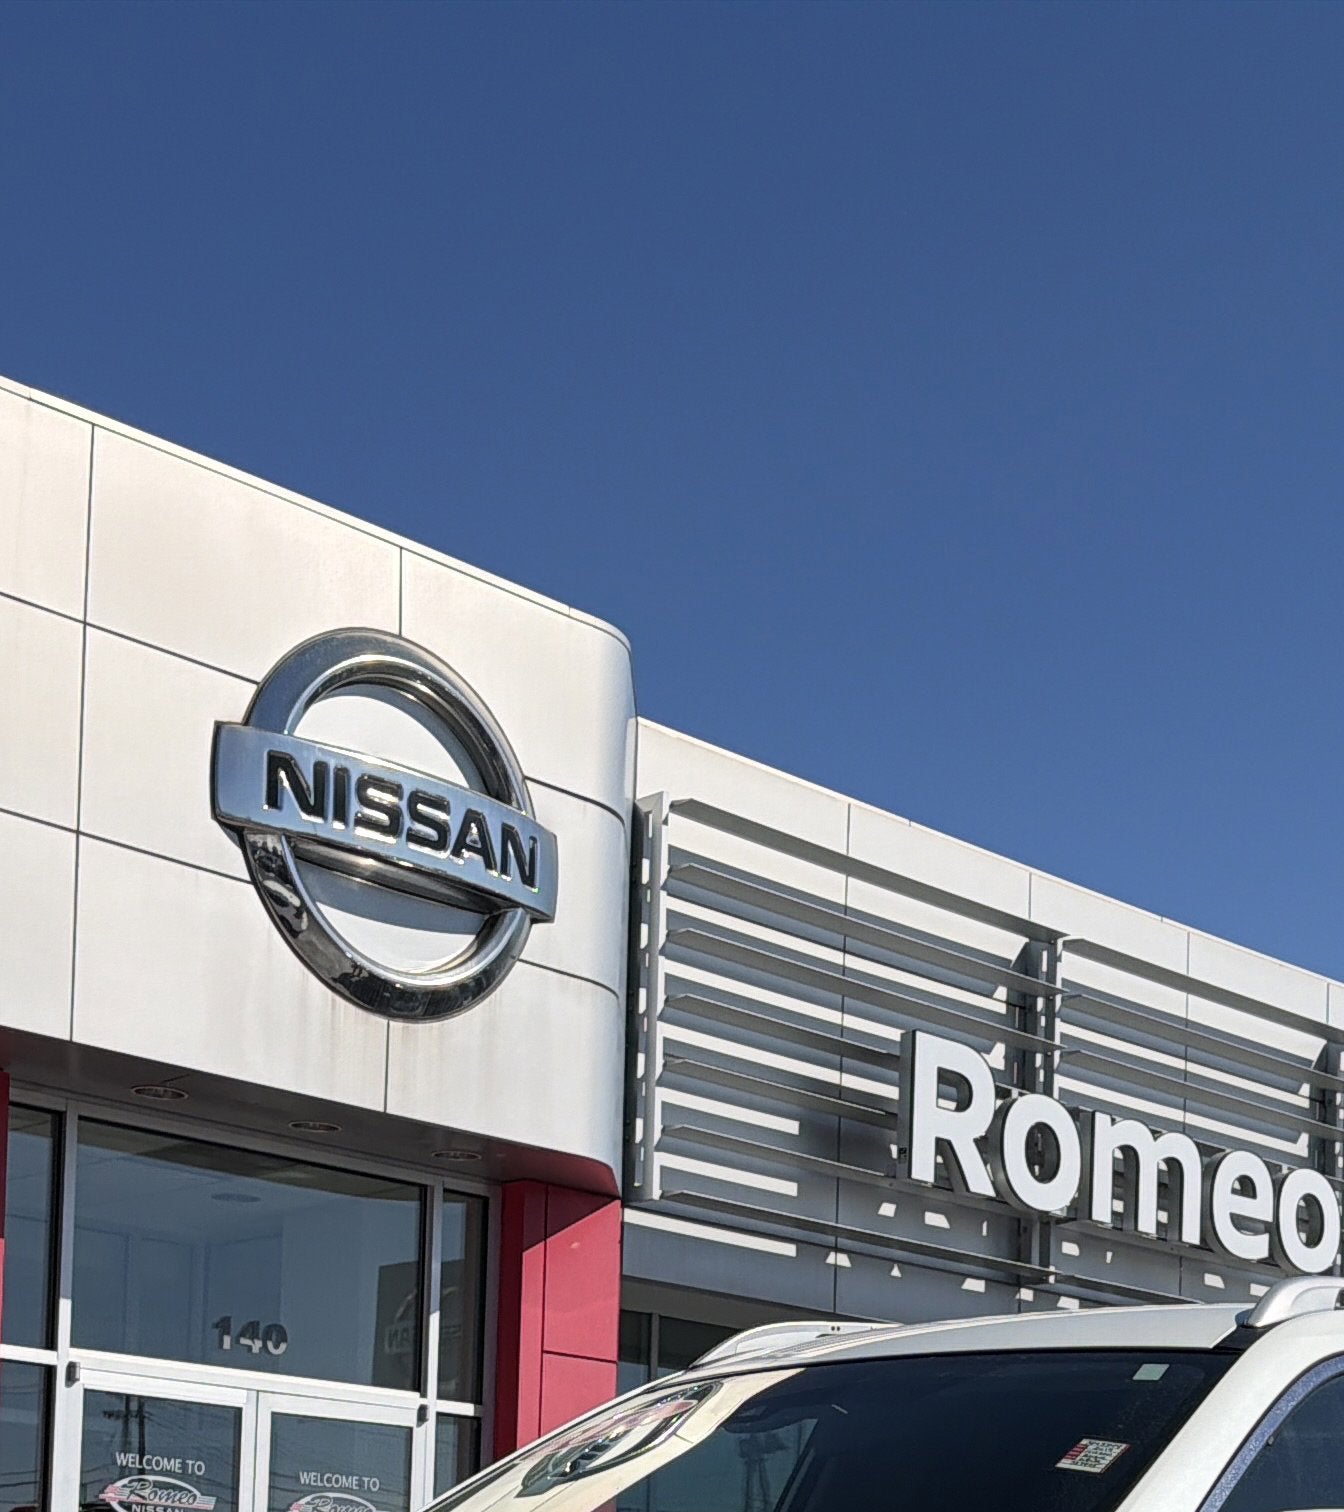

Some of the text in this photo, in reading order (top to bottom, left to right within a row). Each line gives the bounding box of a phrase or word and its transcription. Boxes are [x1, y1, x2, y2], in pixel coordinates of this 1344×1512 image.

[263, 749, 540, 893] NISSAN
[897, 1029, 1341, 1275] Romeo
[212, 1316, 288, 1355] 140
[116, 1452, 206, 1475] WELCOME TO
[123, 1478, 198, 1505] Romeo
[299, 1471, 380, 1491] WELCOME TO
